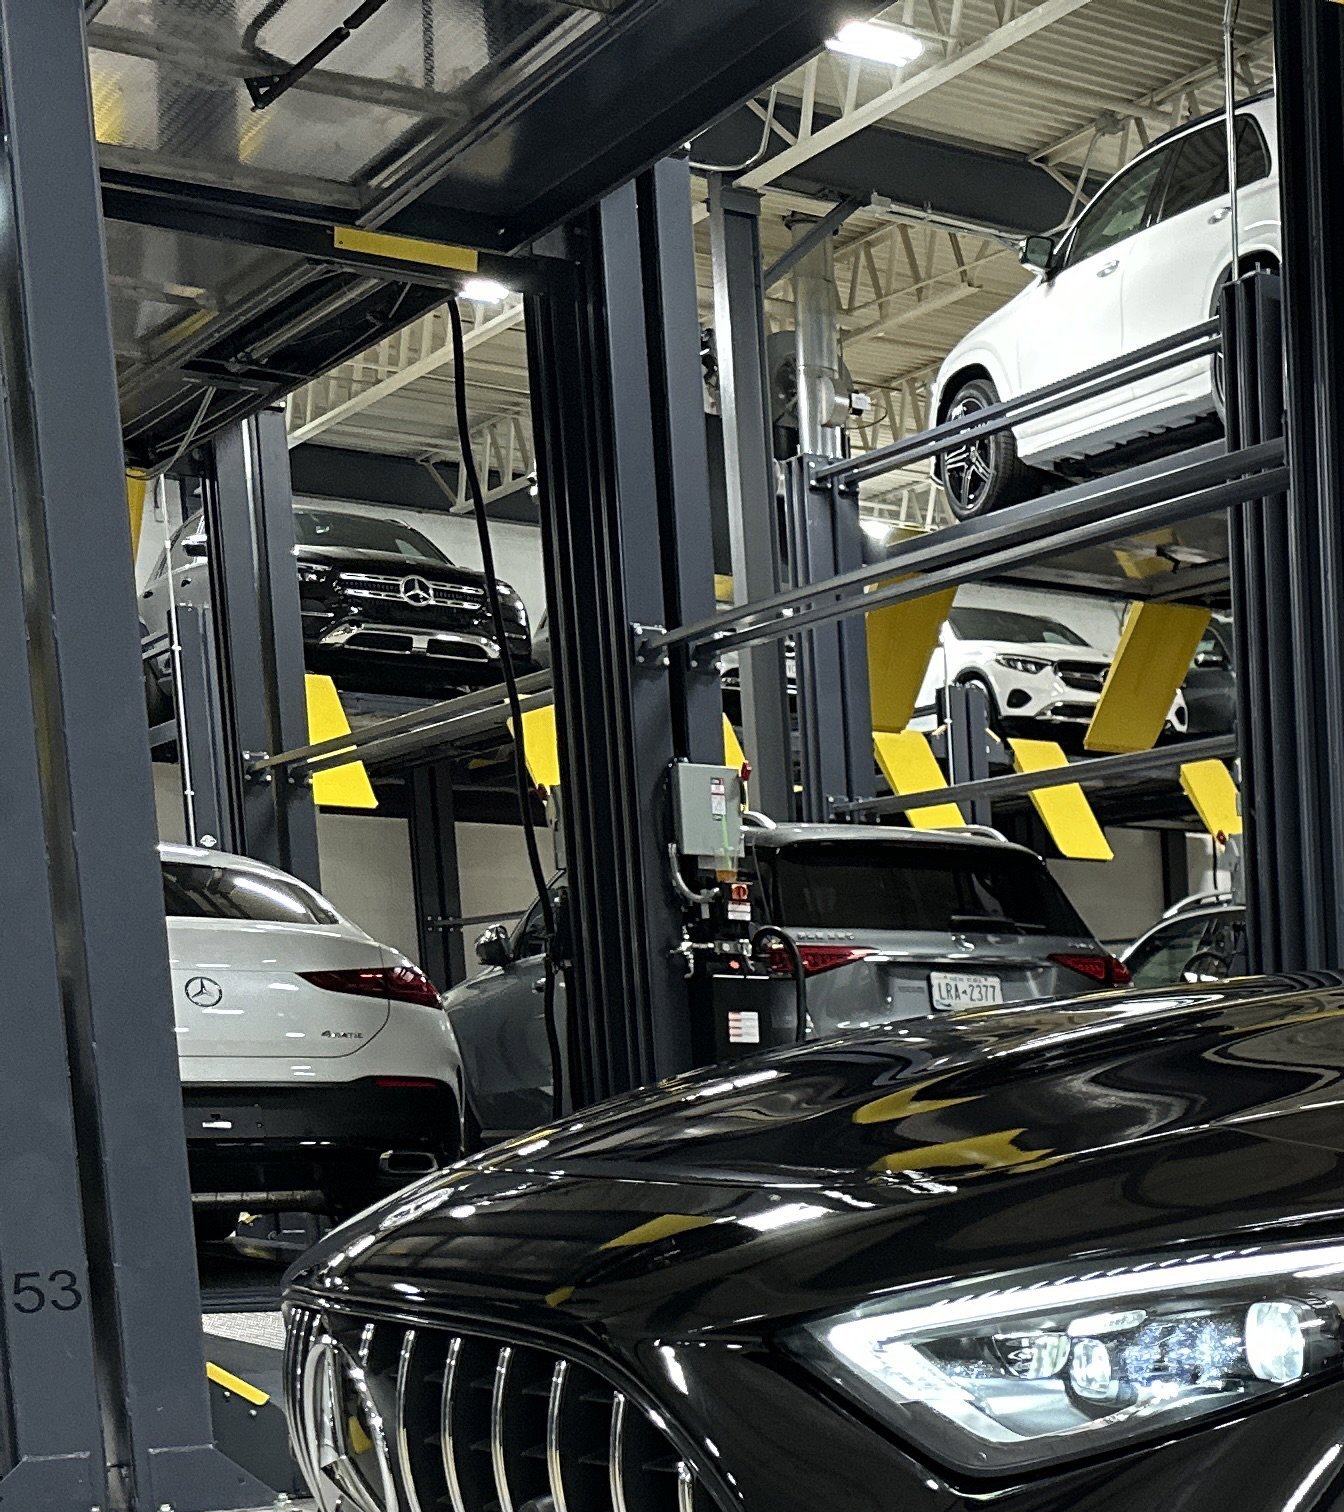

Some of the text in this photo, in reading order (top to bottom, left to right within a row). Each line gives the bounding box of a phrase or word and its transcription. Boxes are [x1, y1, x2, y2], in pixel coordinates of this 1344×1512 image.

[938, 982, 961, 1001] LRA
[968, 984, 997, 1002] 2377
[13, 1269, 82, 1313] 53
